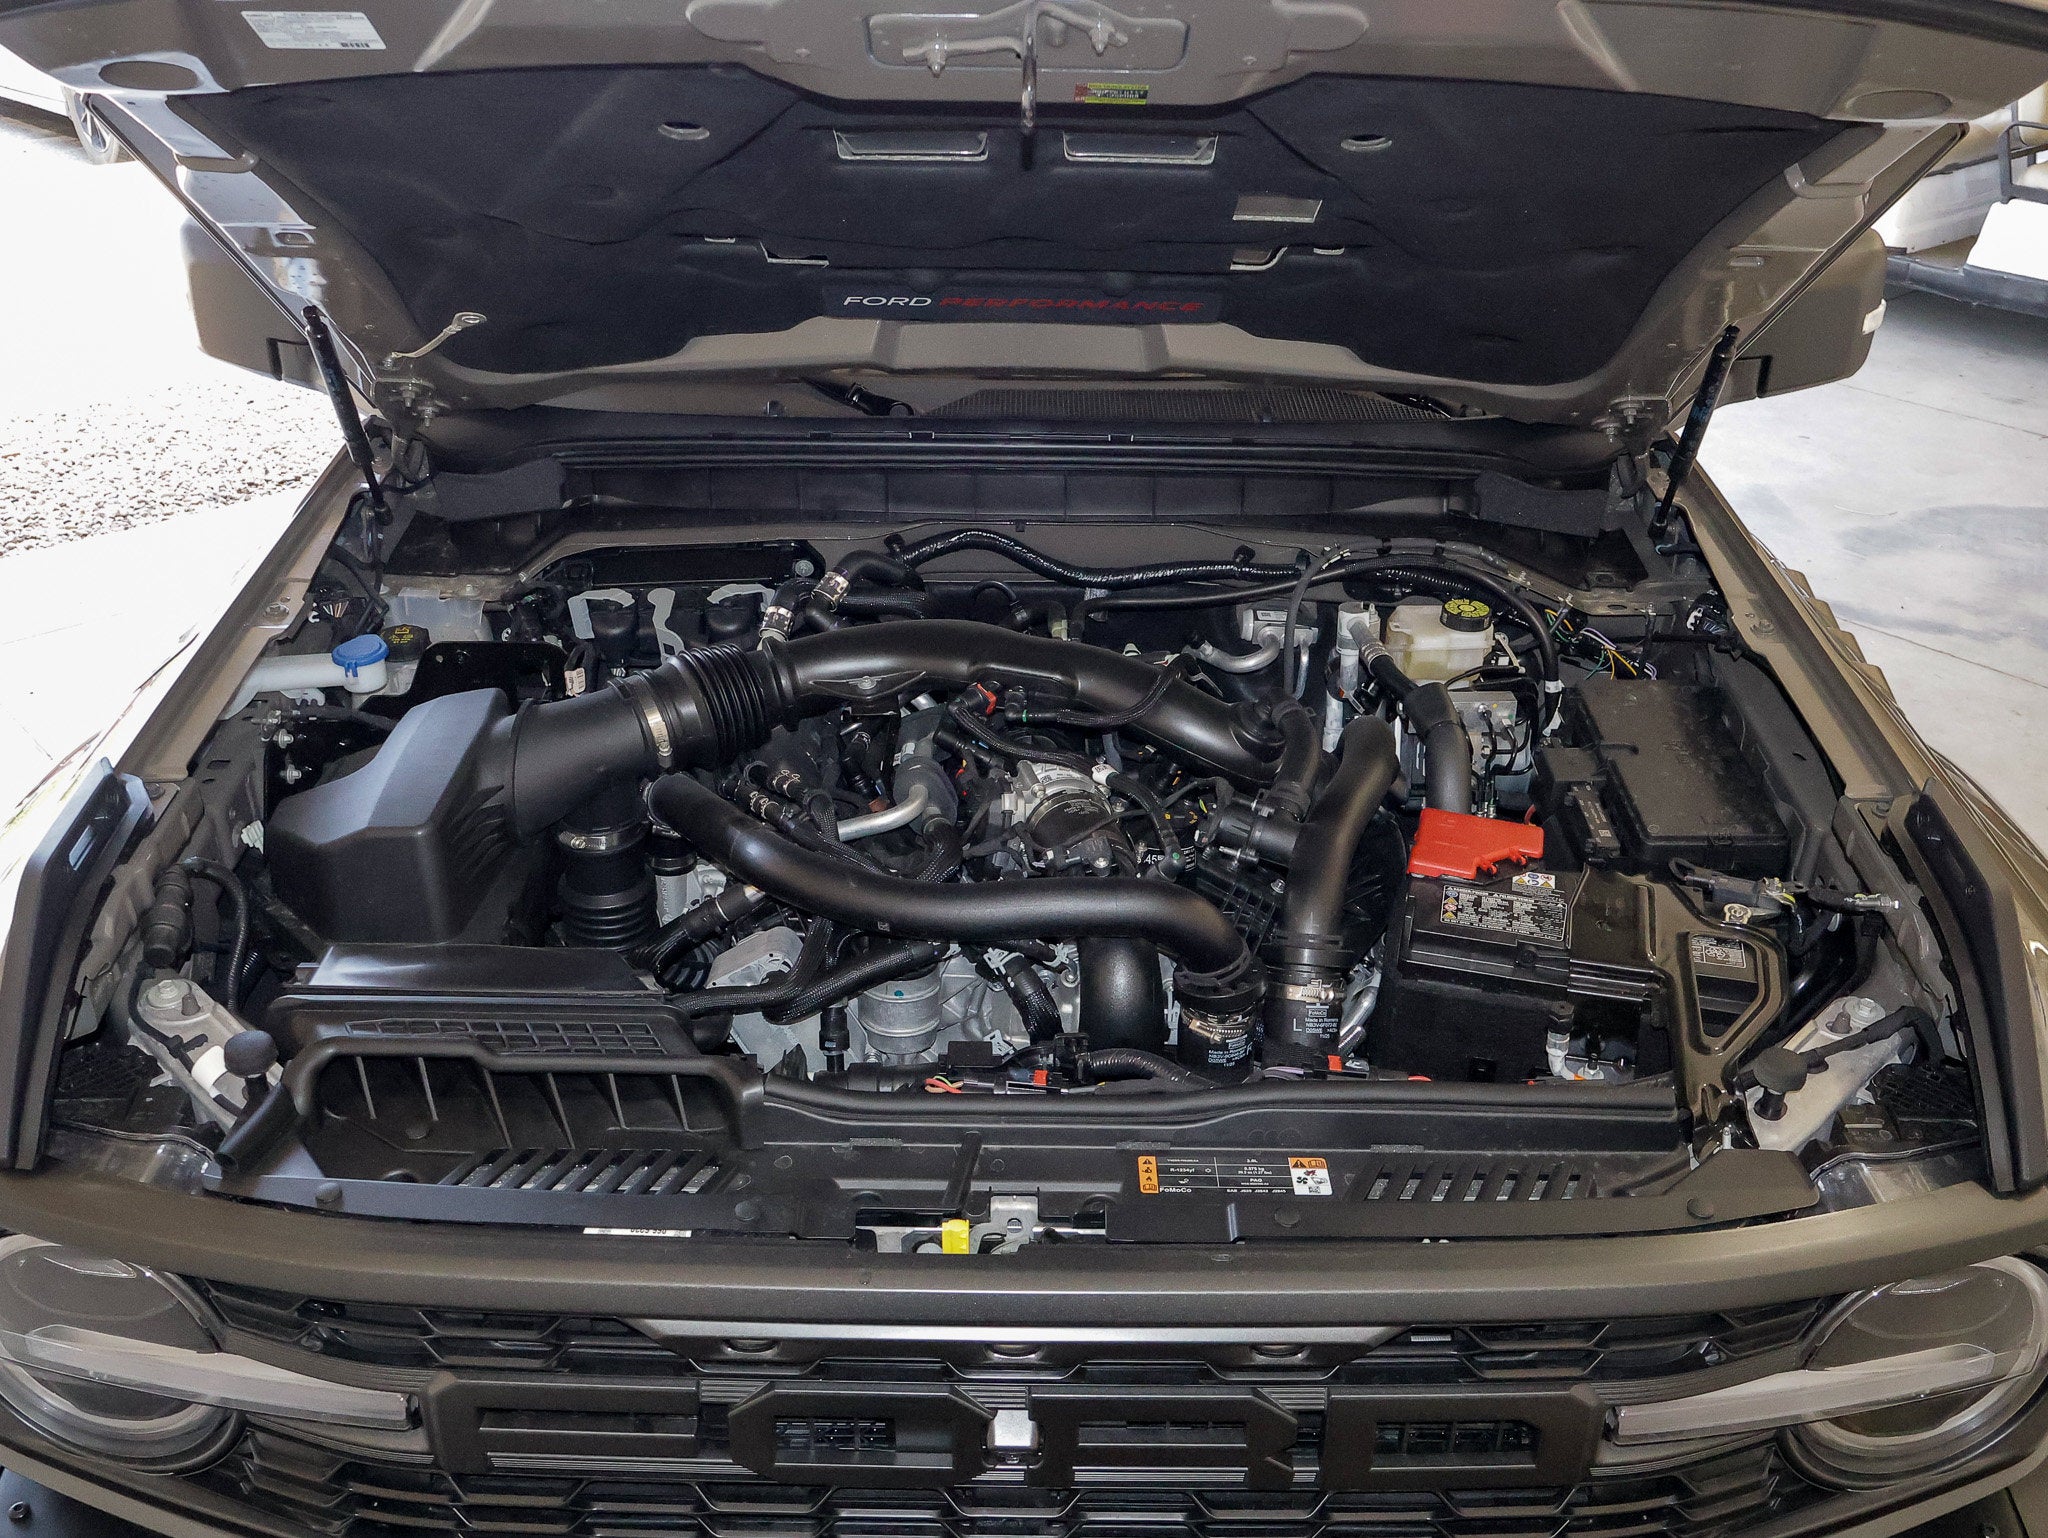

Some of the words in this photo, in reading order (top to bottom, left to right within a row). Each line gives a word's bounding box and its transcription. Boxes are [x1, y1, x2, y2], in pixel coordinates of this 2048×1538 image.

[843, 296, 932, 306] FORD
[939, 298, 1204, 311] PERFORMANCE
[1293, 1018, 1302, 1031] L
